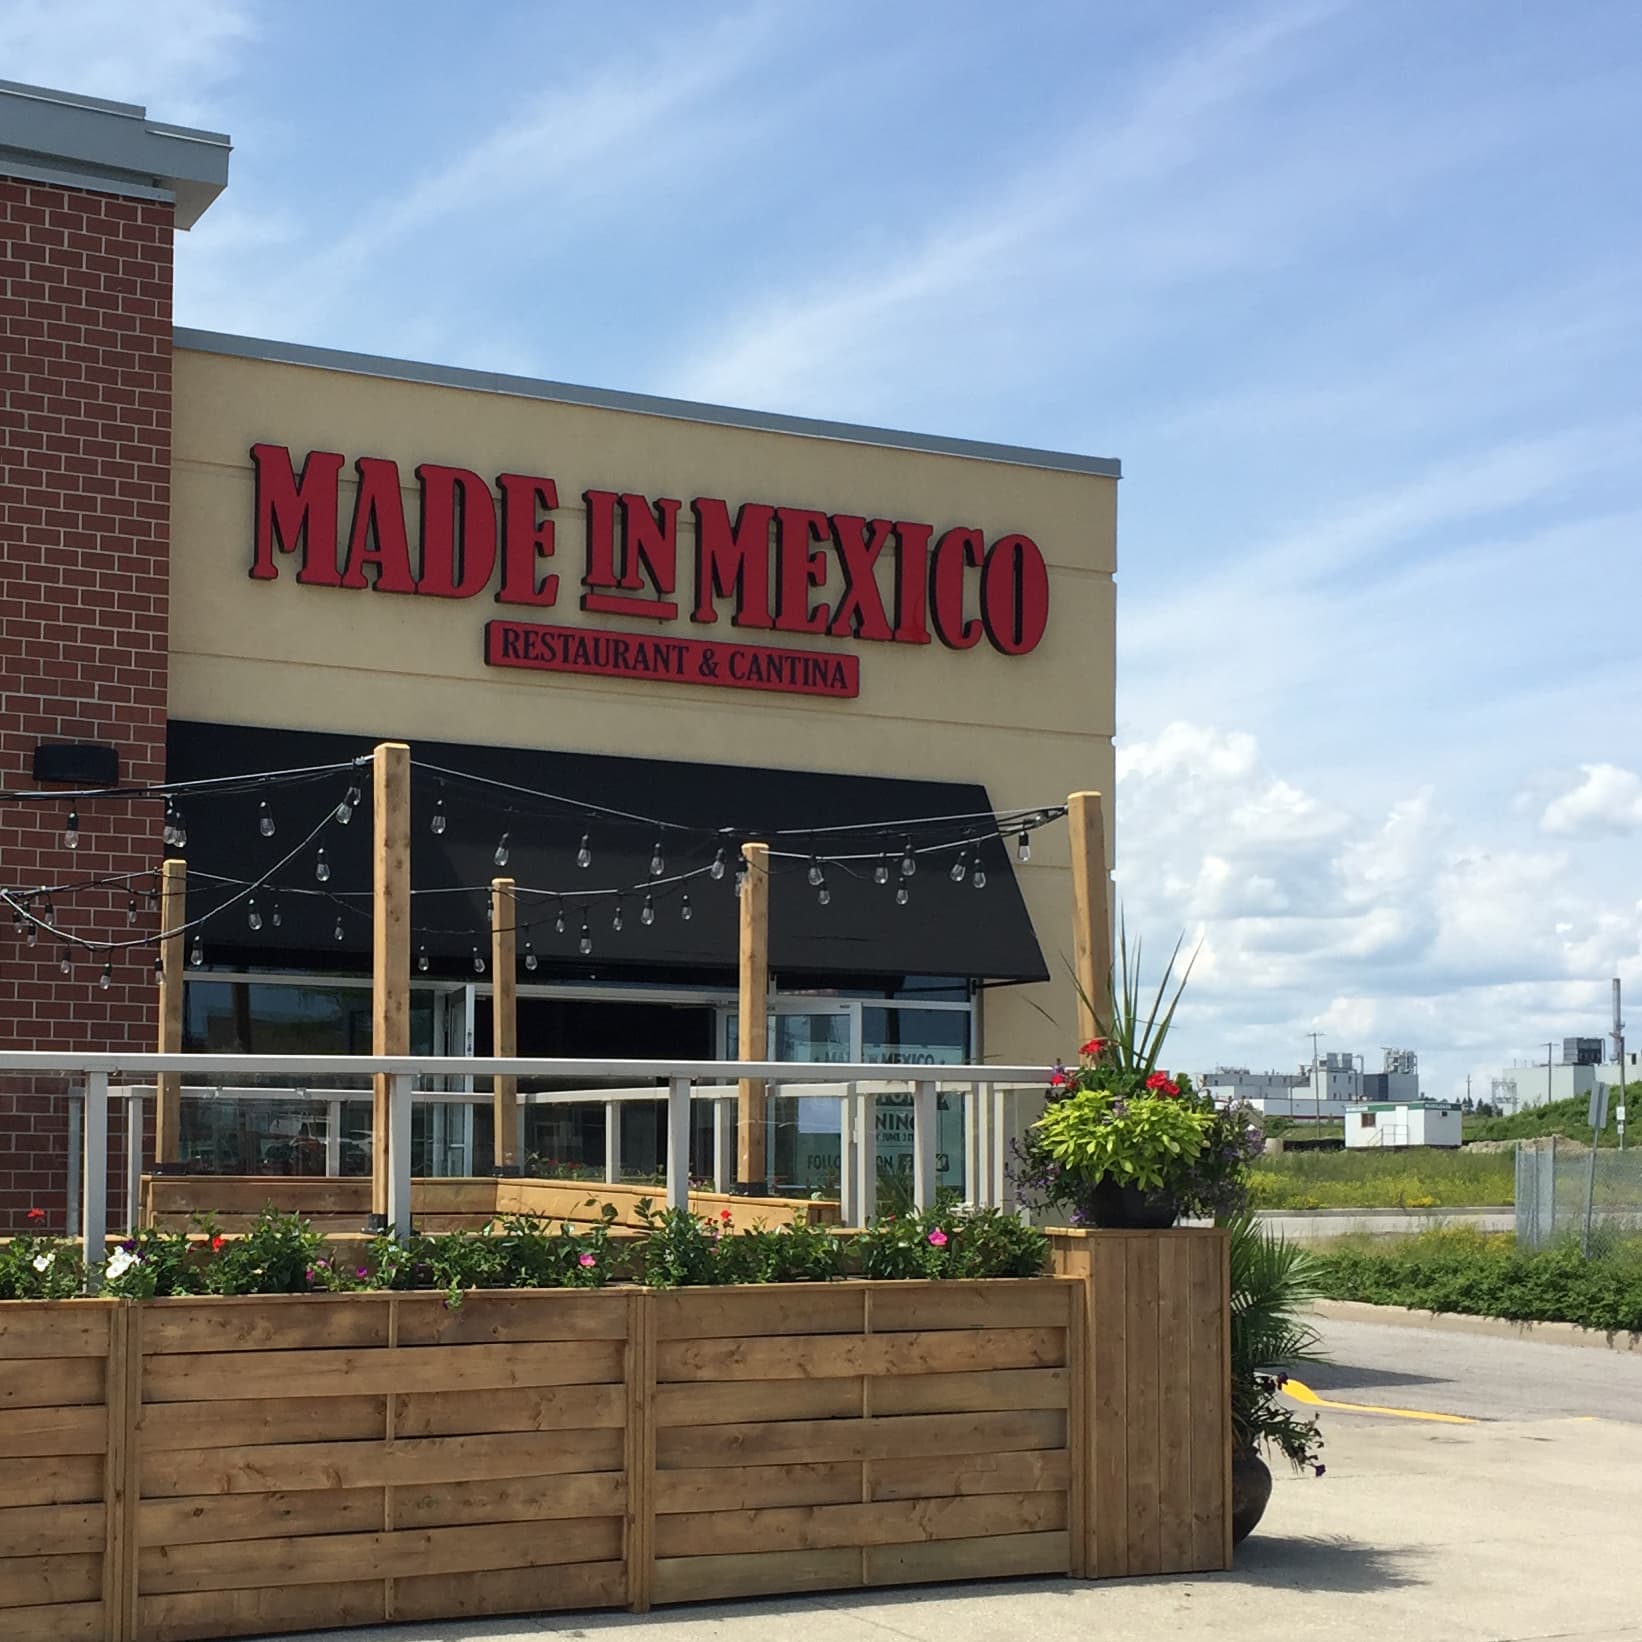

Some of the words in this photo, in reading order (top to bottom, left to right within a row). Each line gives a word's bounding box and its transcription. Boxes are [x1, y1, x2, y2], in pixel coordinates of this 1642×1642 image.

[249, 443, 560, 607] MADE
[581, 488, 681, 597] IN
[690, 497, 1050, 655] MEXICO
[502, 627, 688, 675] RESTAURANT
[698, 648, 719, 678] &
[728, 650, 849, 689] CANTINA
